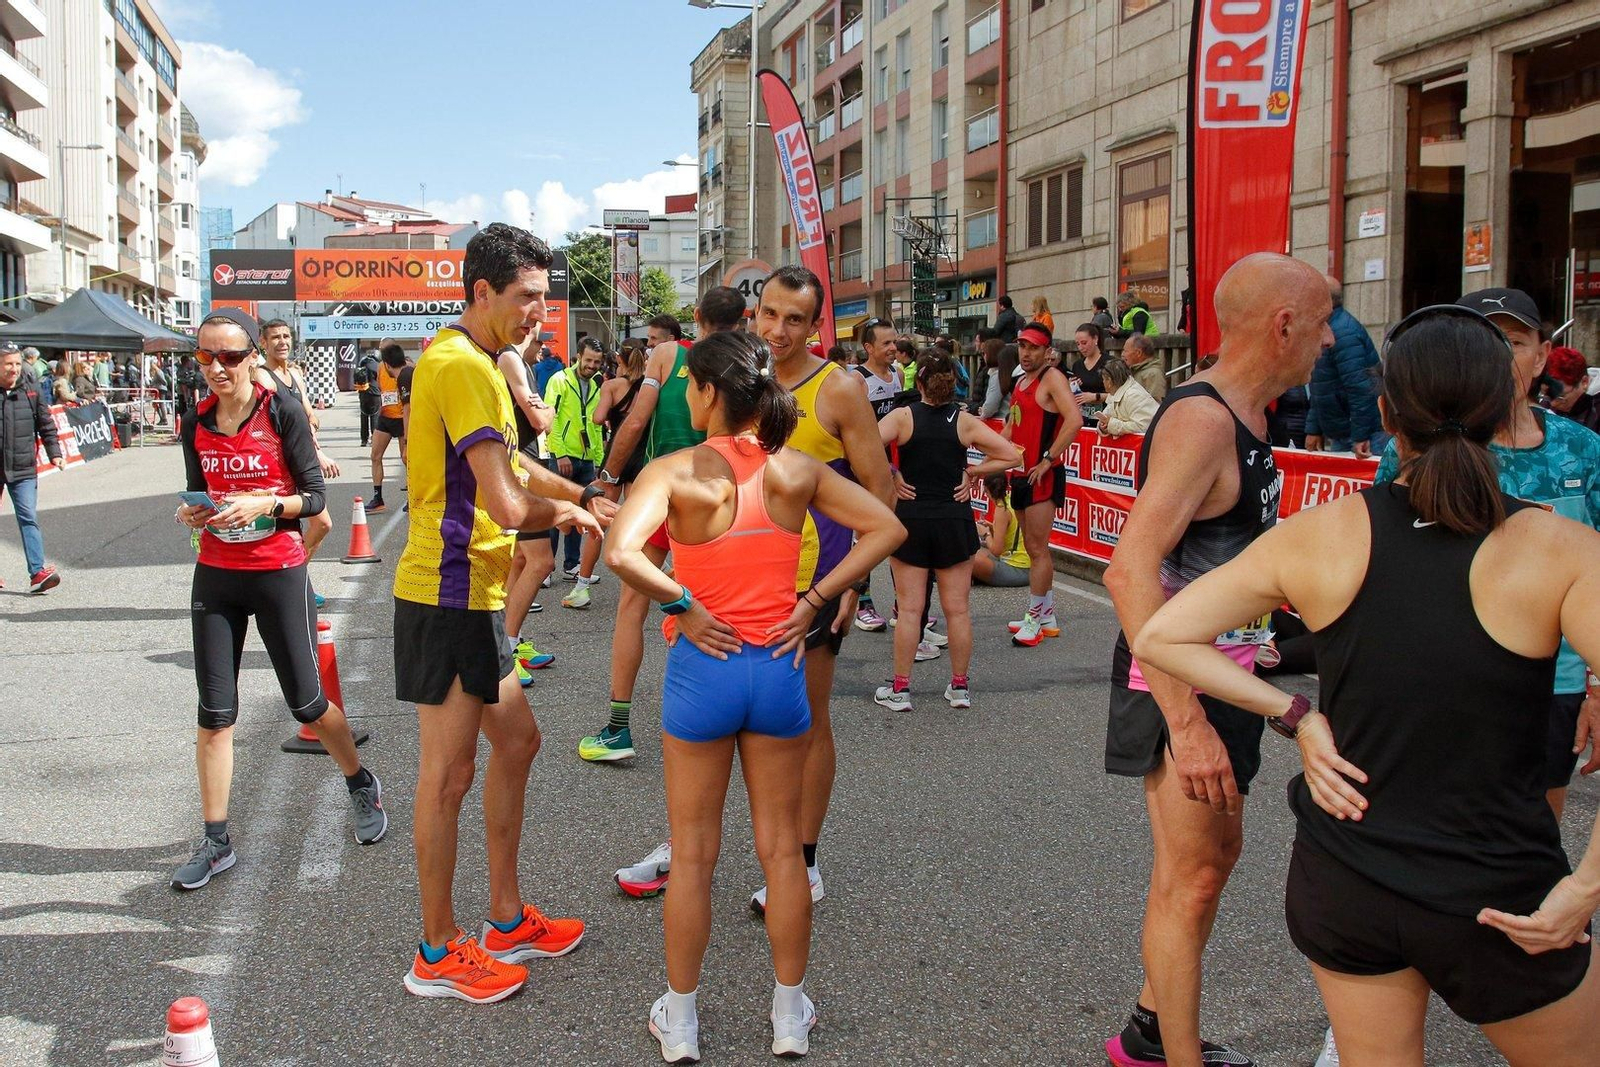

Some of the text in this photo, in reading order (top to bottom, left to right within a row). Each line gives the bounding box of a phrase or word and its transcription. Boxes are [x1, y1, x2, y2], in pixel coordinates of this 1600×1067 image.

[1273, 2, 1295, 87] Siempre a
[784, 125, 823, 243] FROIZ
[621, 216, 648, 224] Manolo
[372, 289, 388, 298] 10K
[738, 279, 763, 298] 40
[373, 322, 419, 332] 00:37:25
[222, 456, 245, 472] 10
[1093, 447, 1135, 477] FROIZ
